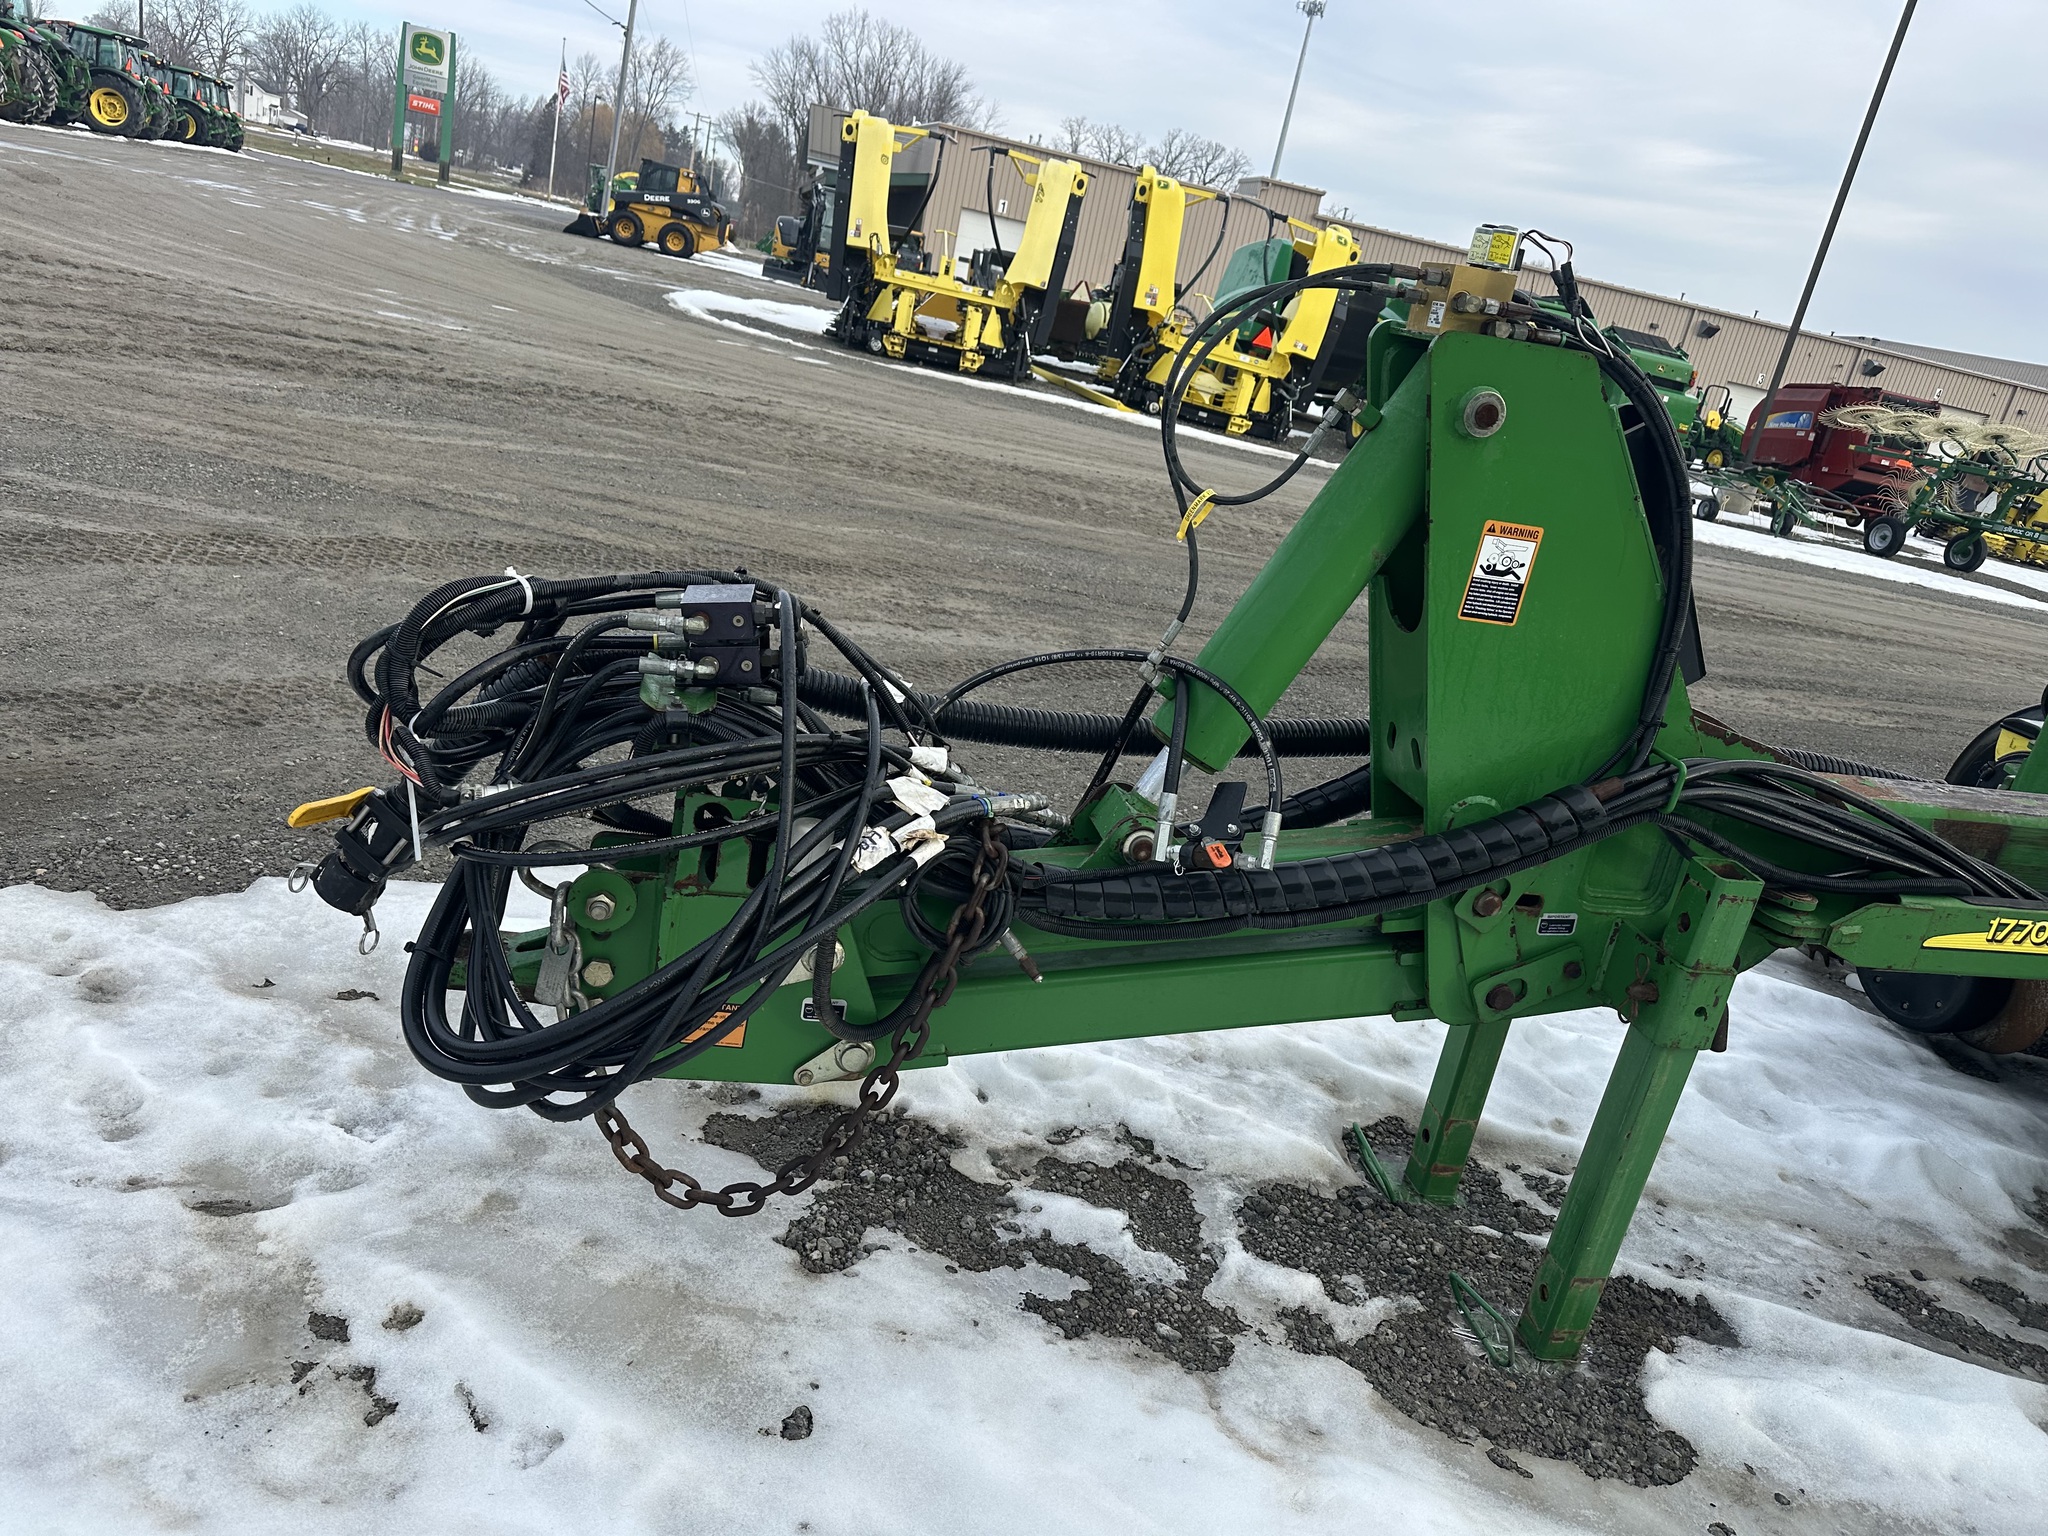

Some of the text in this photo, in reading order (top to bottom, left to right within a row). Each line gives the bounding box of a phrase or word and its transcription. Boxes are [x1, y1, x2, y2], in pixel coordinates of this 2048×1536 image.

[424, 67, 443, 76] DEERE
[412, 99, 436, 110] STIHL
[643, 193, 670, 203] DEERE
[1499, 524, 1540, 540] WARNING
[1986, 916, 2048, 946] 1770
